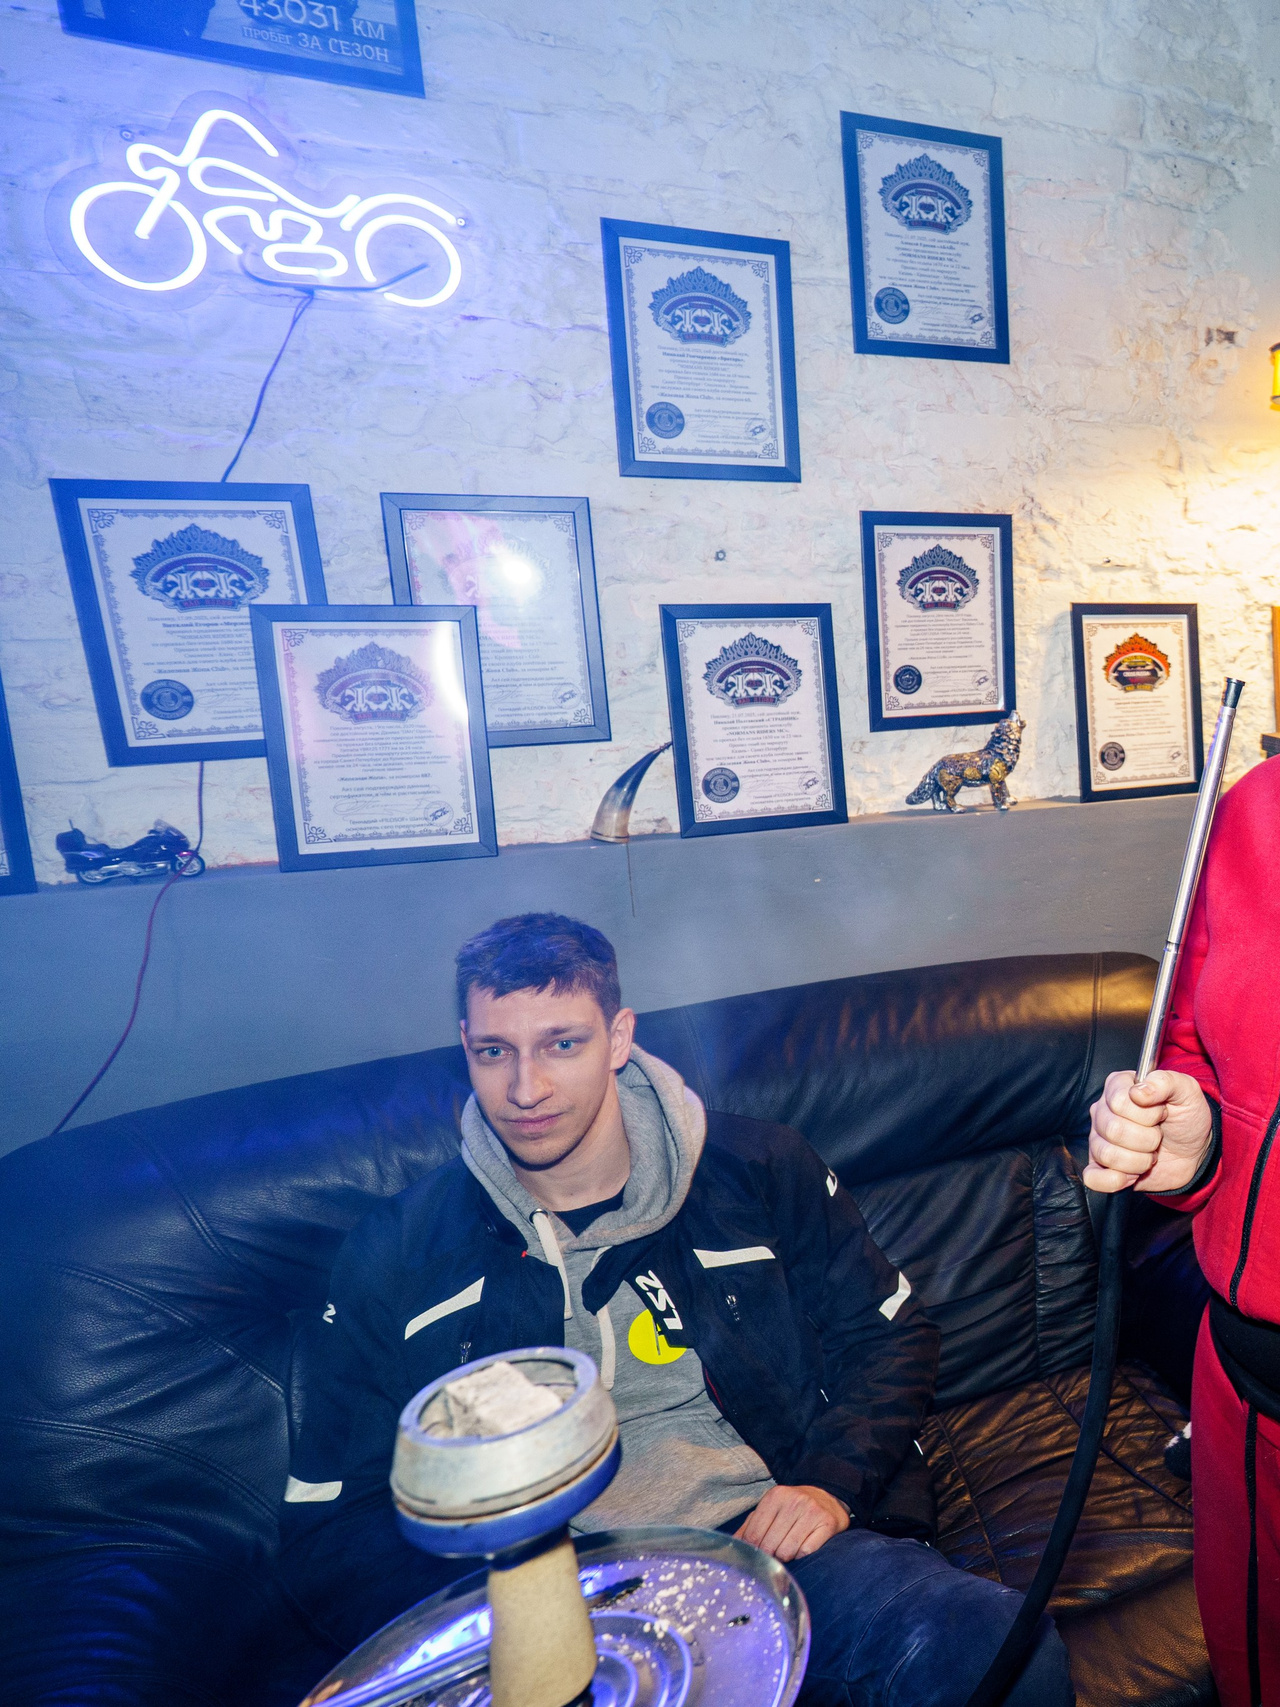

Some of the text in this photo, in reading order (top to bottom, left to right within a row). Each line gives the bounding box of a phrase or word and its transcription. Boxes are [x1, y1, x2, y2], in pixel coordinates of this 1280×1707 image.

[242, 26, 390, 63] ПРОБЕГ ЗА СЕЗОН
[351, 18, 386, 41] КМ
[635, 1269, 683, 1330] LS2
